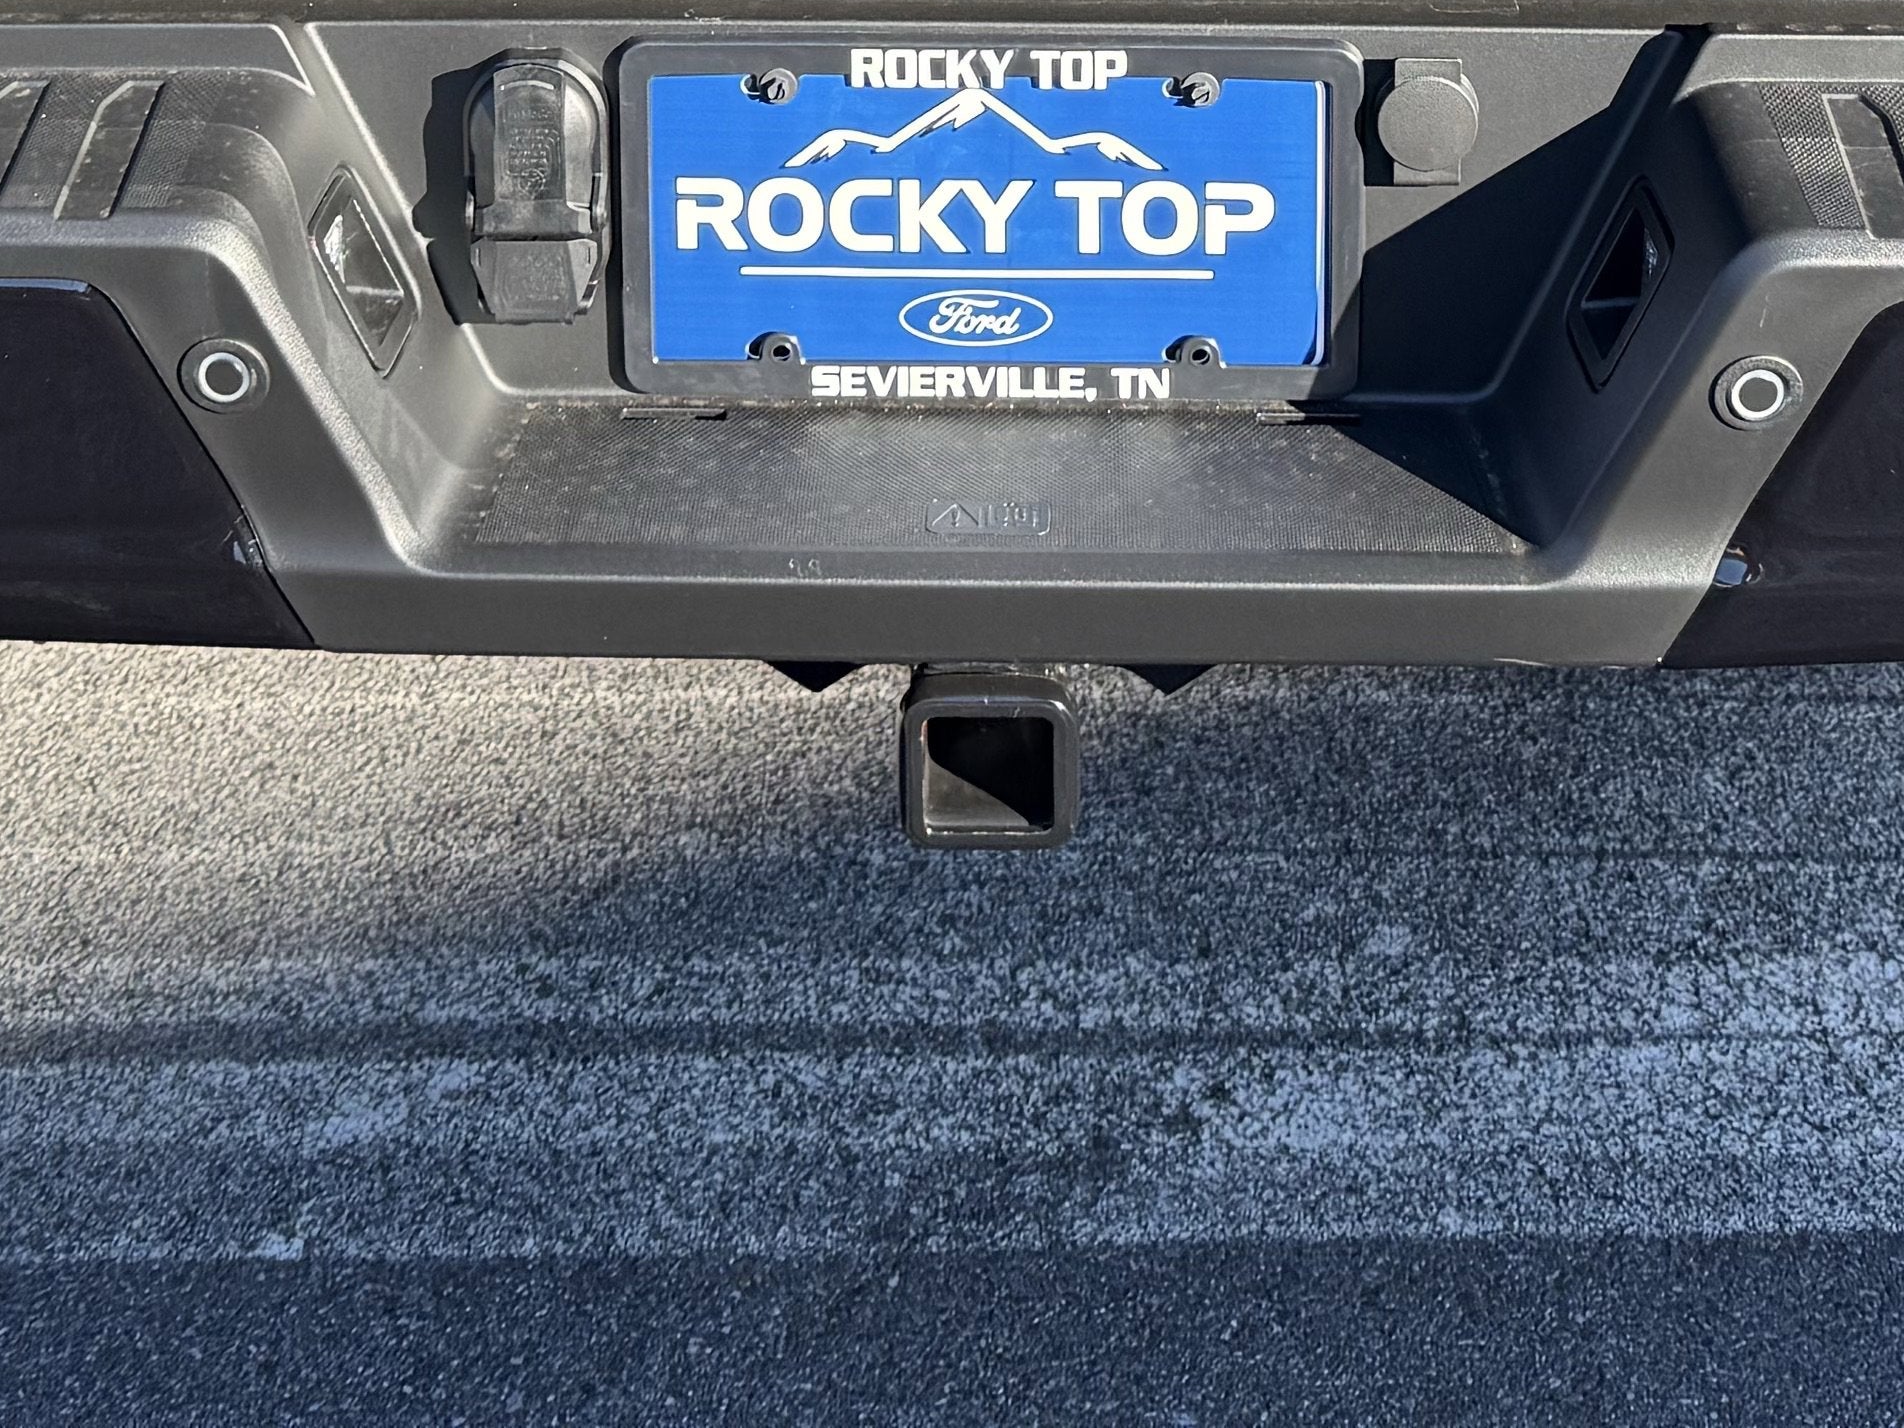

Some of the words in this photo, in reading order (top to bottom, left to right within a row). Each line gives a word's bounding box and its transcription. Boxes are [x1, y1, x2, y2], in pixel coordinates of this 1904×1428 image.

[849, 47, 1015, 90] ROCKY
[1029, 48, 1128, 91] TOP
[675, 175, 1035, 255] ROCKY
[1053, 179, 1276, 256] TOP
[927, 295, 1022, 336] Ford
[809, 363, 1098, 403] SEVIERVILLE,
[1109, 366, 1170, 400] TN
